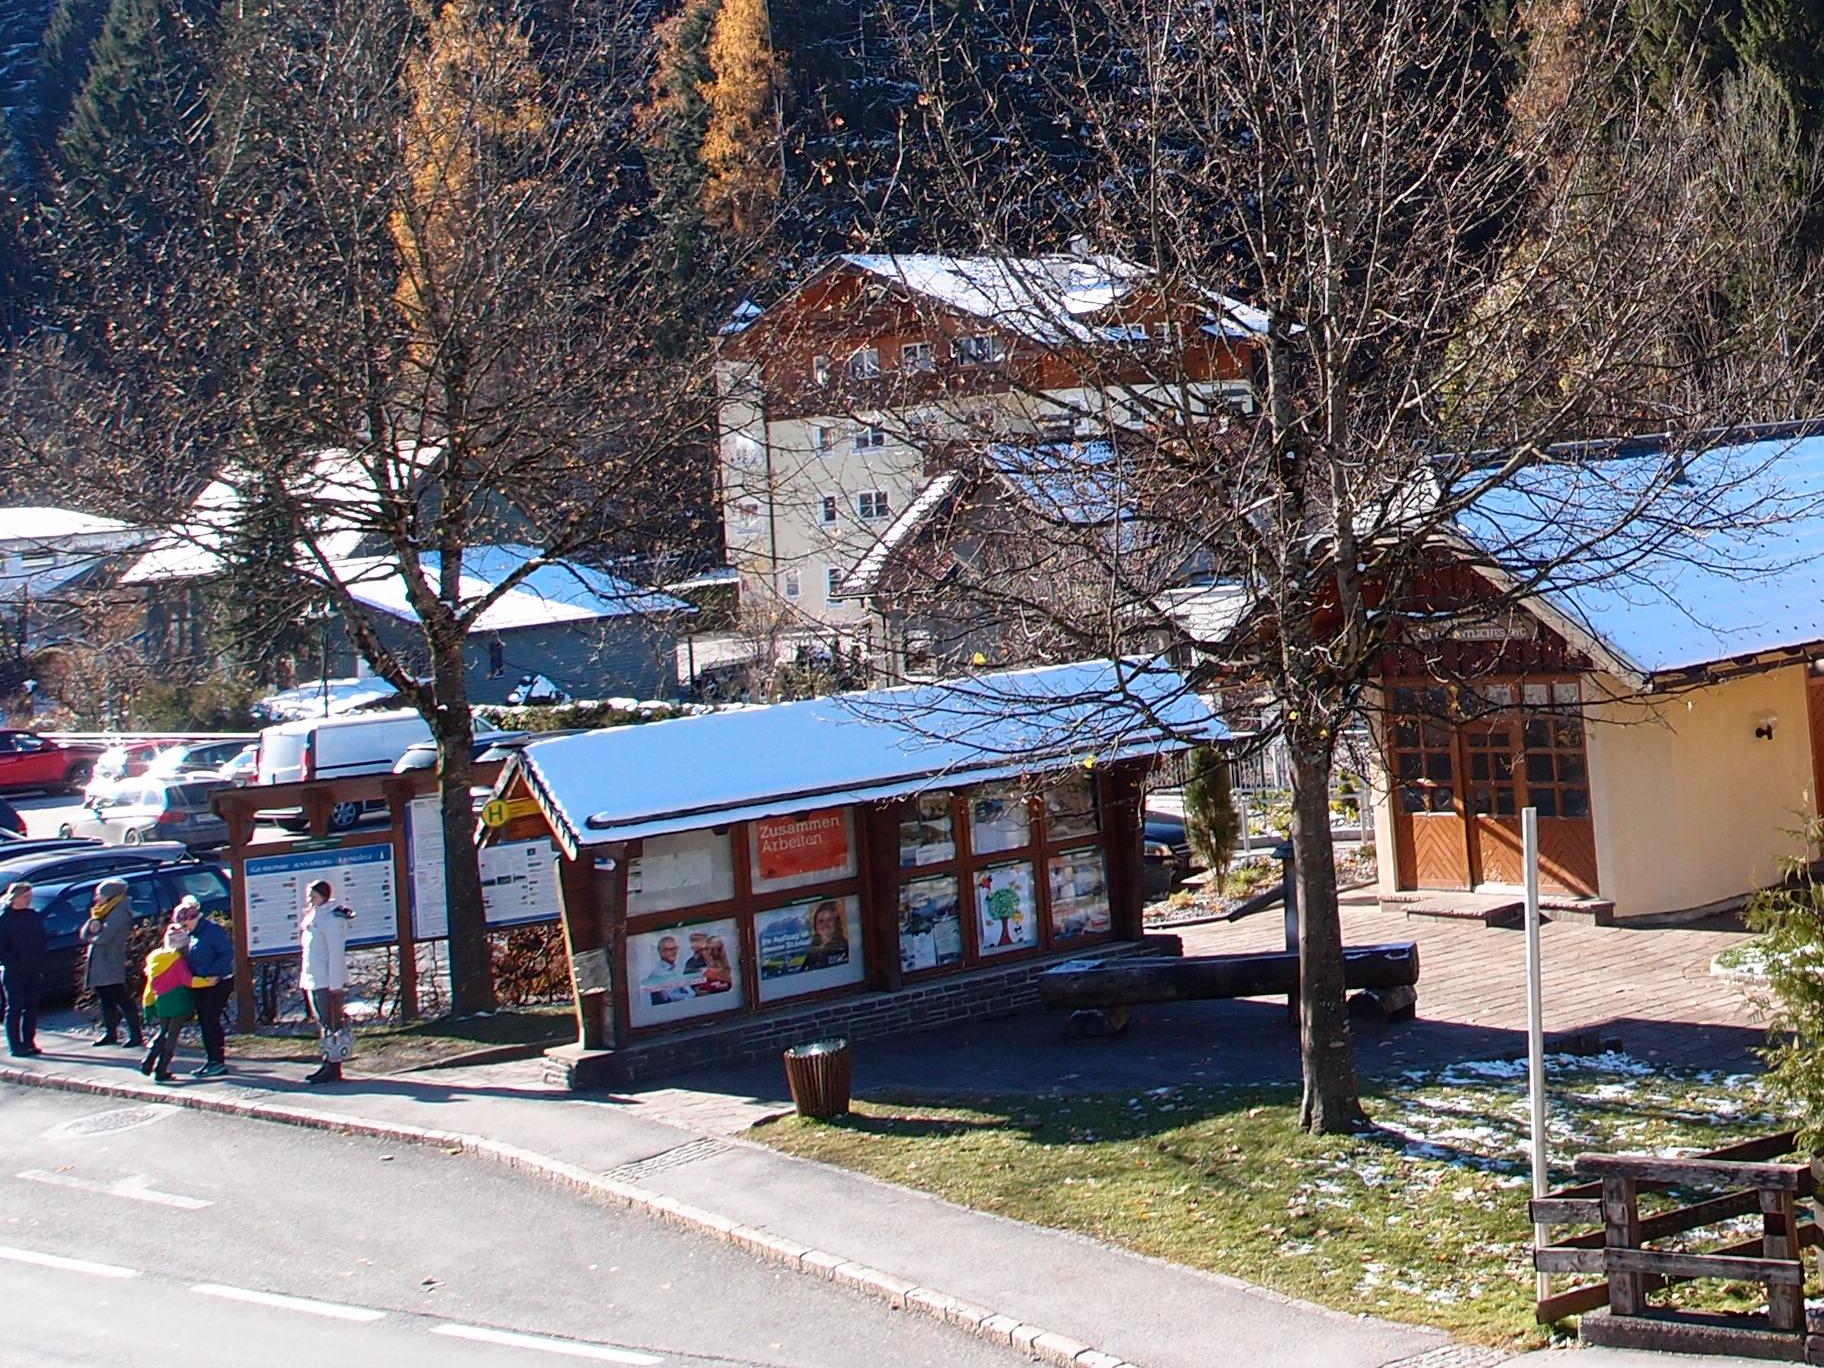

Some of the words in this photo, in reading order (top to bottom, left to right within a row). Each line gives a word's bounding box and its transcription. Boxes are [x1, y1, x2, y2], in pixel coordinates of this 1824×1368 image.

[488, 804, 503, 823] H
[760, 816, 840, 839] Zusammen
[762, 833, 822, 853] Arbeiten
